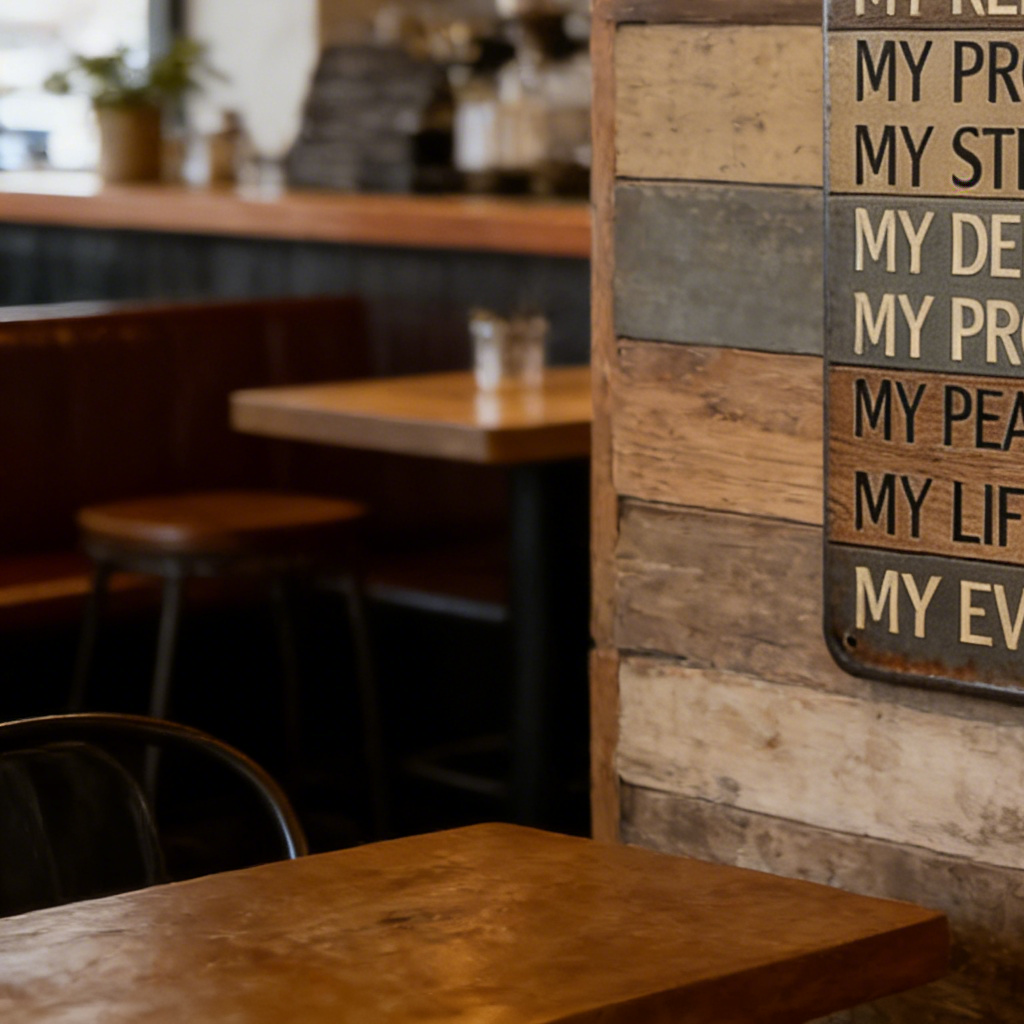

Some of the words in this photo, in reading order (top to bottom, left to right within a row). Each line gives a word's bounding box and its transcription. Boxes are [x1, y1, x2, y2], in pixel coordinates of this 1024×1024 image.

[856, 40, 933, 104] MY
[855, 125, 934, 187] MY
[855, 208, 934, 274] MY
[853, 292, 934, 359] MY
[854, 378, 926, 444] MY
[854, 471, 932, 538] MY
[854, 566, 942, 639] MY
